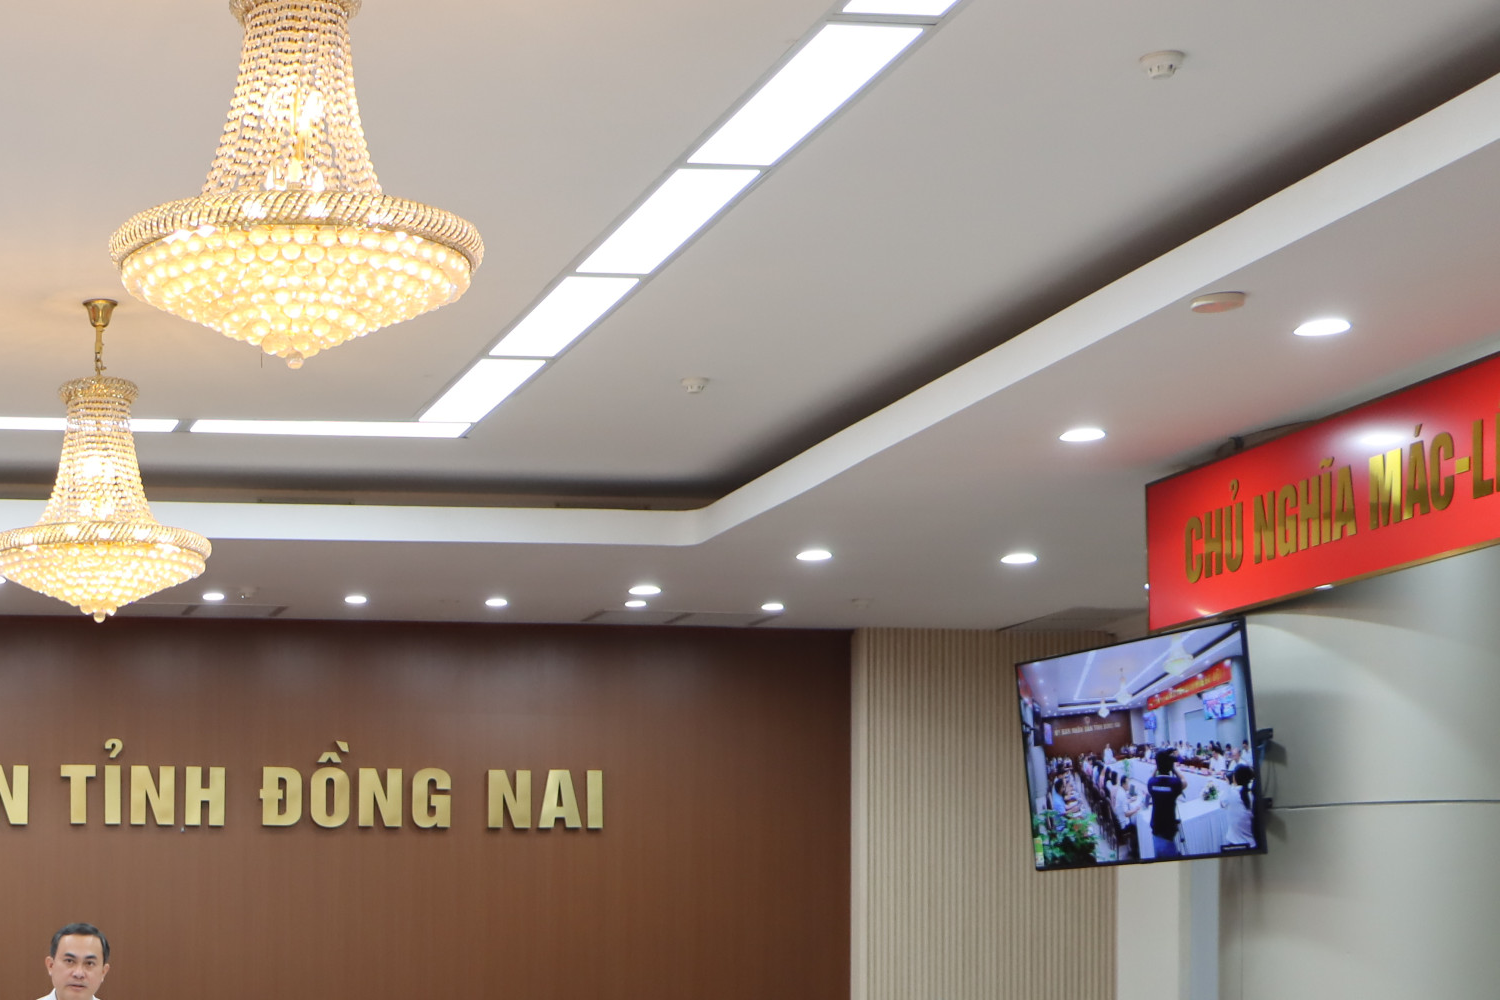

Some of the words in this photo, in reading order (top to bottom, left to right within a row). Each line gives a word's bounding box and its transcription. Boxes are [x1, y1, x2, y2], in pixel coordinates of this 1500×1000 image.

[1185, 479, 1243, 584] CHỦ
[1253, 456, 1357, 564] NGHĨA
[1369, 412, 1500, 531] MÁC-L
[60, 738, 226, 827] TỈNH
[259, 740, 451, 829] ĐỒNG
[488, 769, 603, 829] NAI
